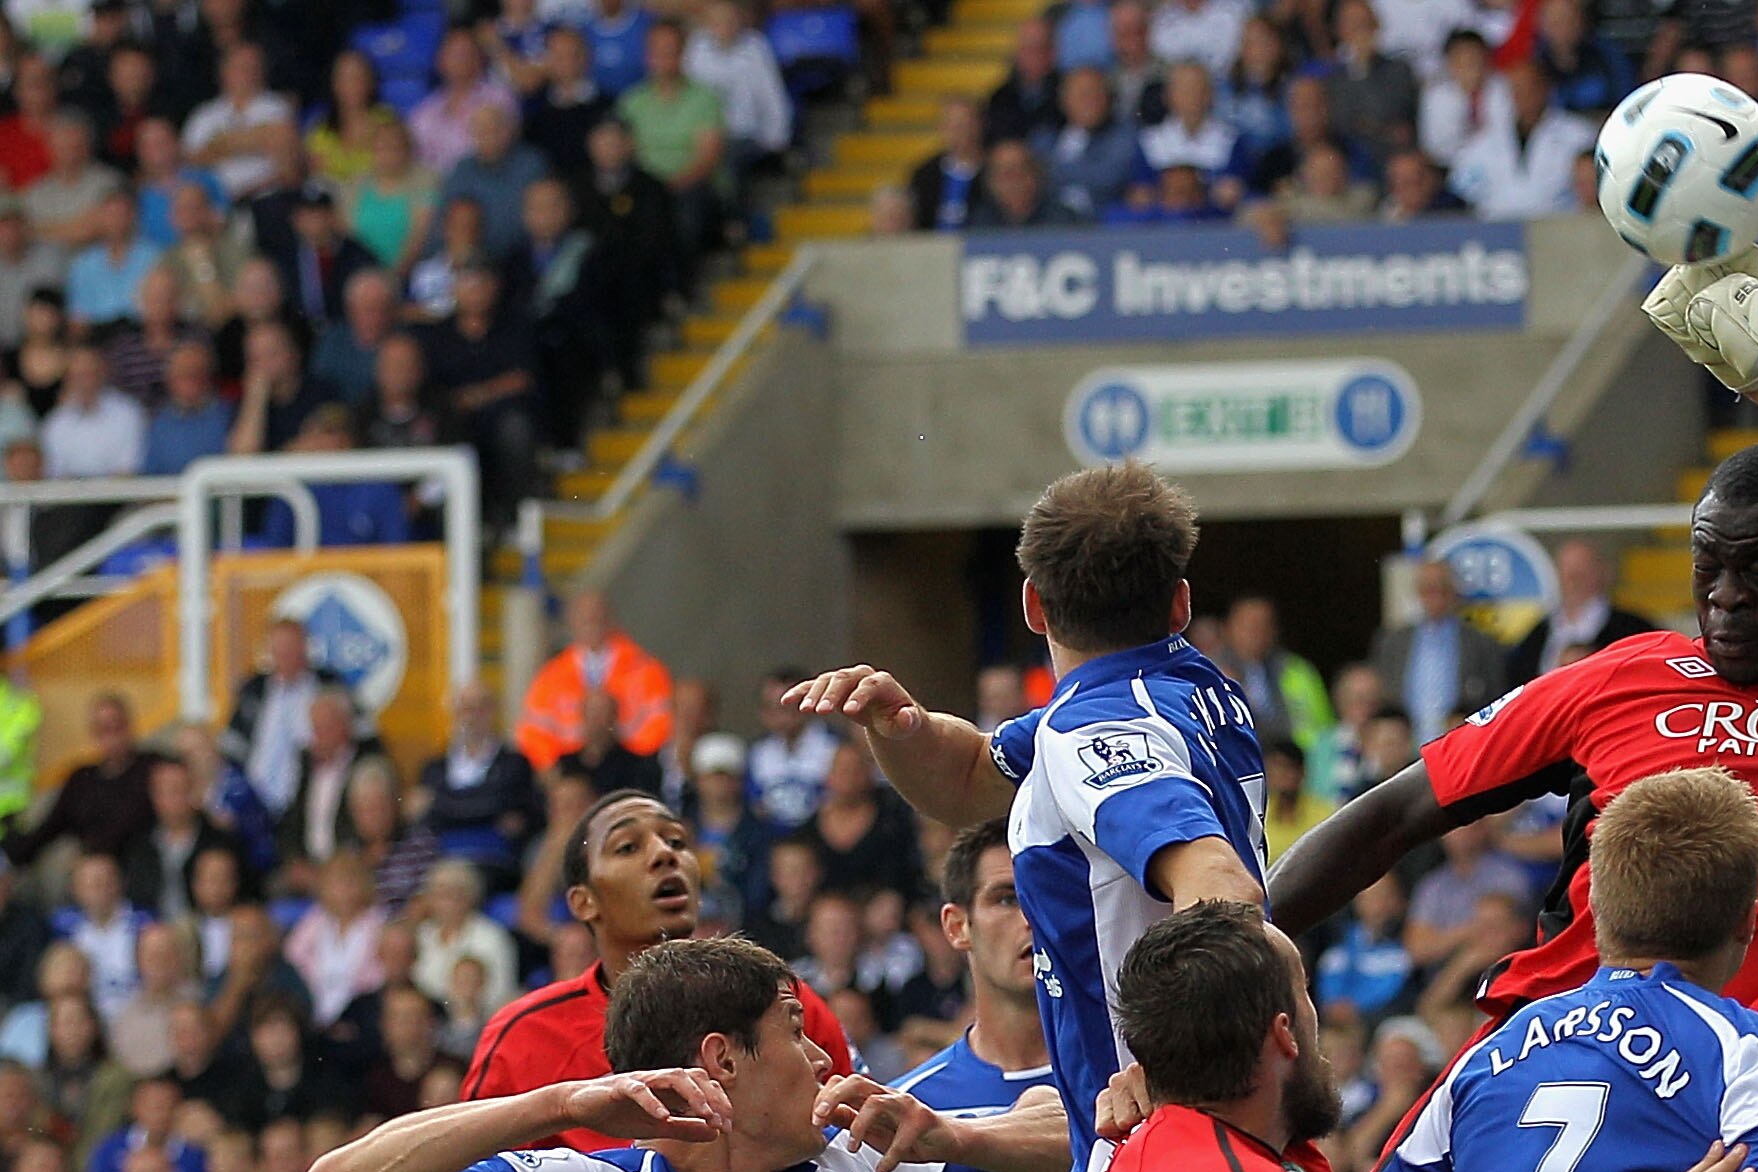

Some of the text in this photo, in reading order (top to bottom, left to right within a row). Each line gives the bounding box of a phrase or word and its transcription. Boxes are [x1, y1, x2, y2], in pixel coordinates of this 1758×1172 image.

[961, 242, 1529, 321] F&C Investments
[1488, 999, 1691, 1099] LARSSON
